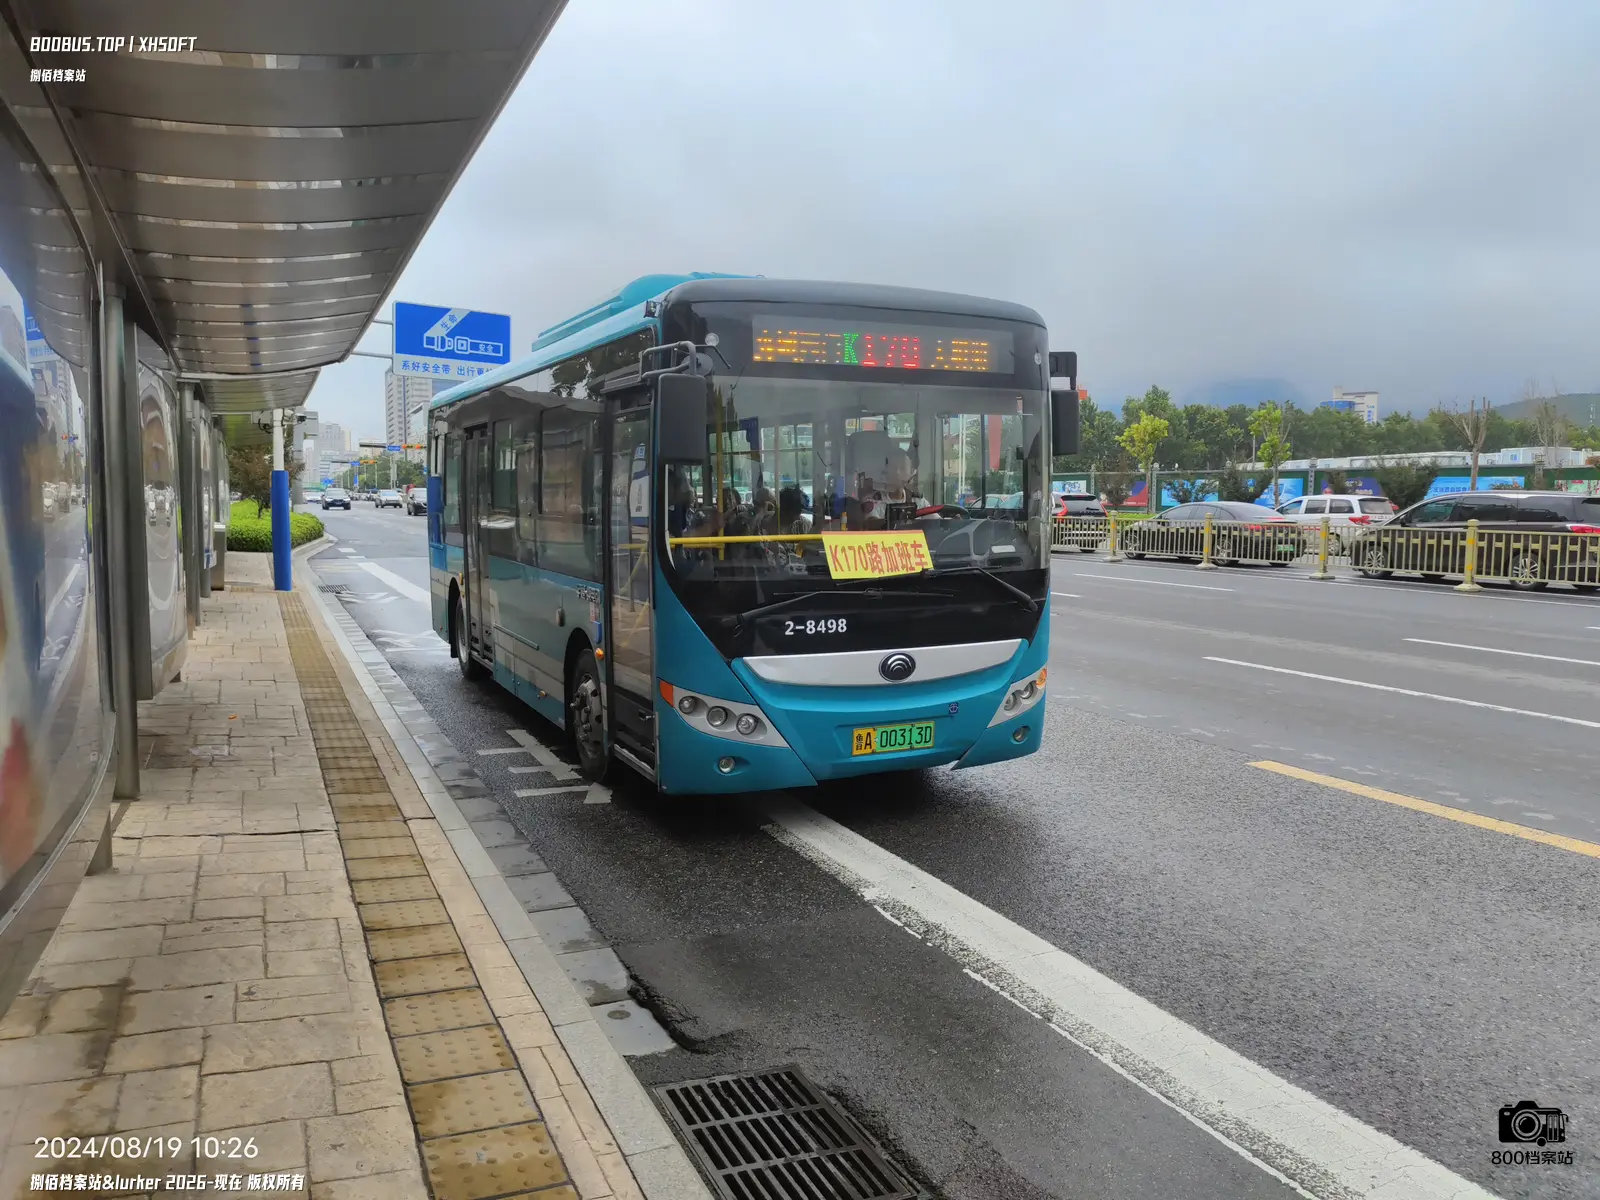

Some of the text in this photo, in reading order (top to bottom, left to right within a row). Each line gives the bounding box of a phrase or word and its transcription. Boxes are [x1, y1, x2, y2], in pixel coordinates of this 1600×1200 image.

[440, 313, 458, 332] 生命
[478, 342, 494, 353] 安全
[401, 360, 493, 378] 系好安全带 出行更
[829, 540, 928, 575] K170路加班车
[784, 618, 848, 636] 2-8498
